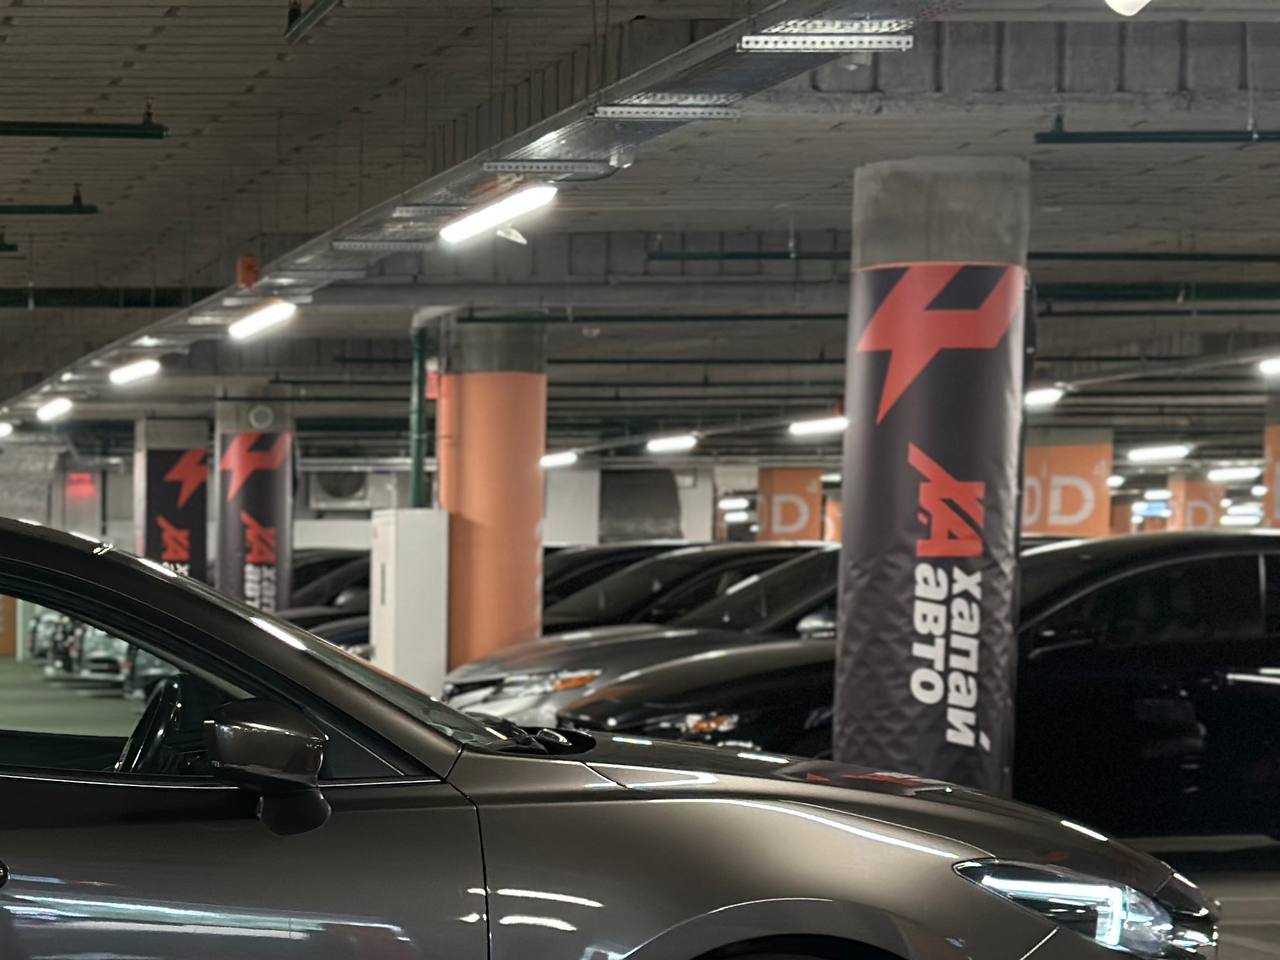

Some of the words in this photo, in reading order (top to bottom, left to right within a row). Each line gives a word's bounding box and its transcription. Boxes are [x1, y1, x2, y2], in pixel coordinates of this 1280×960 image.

[771, 494, 809, 534] D
[1049, 474, 1096, 526] D
[910, 562, 950, 705] авто
[945, 565, 991, 752] хапай
